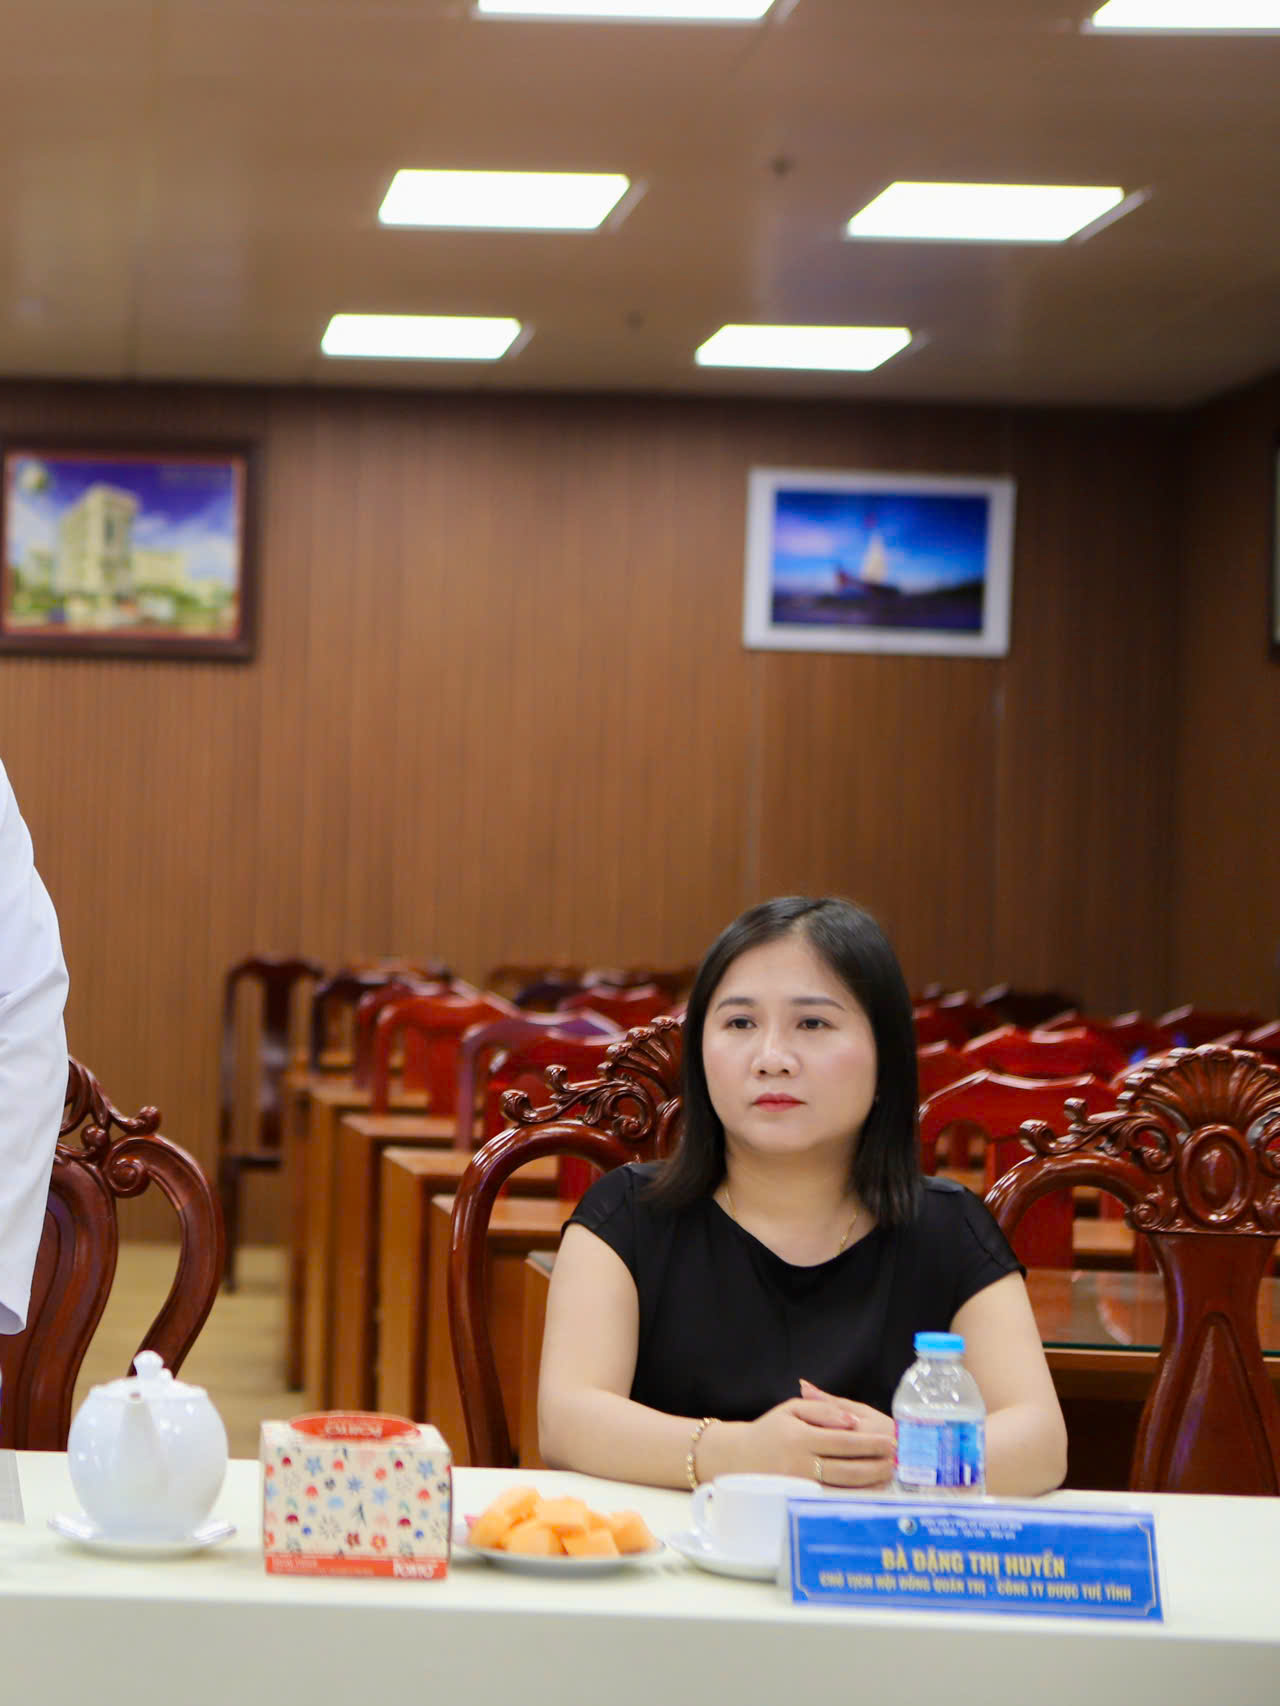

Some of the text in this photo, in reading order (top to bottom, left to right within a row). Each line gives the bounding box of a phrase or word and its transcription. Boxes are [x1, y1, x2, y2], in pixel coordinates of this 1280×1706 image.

[881, 1543, 1066, 1581] BÀ ĐẶNG THỊ HUYỀN
[1031, 1581, 1045, 1598] TY
